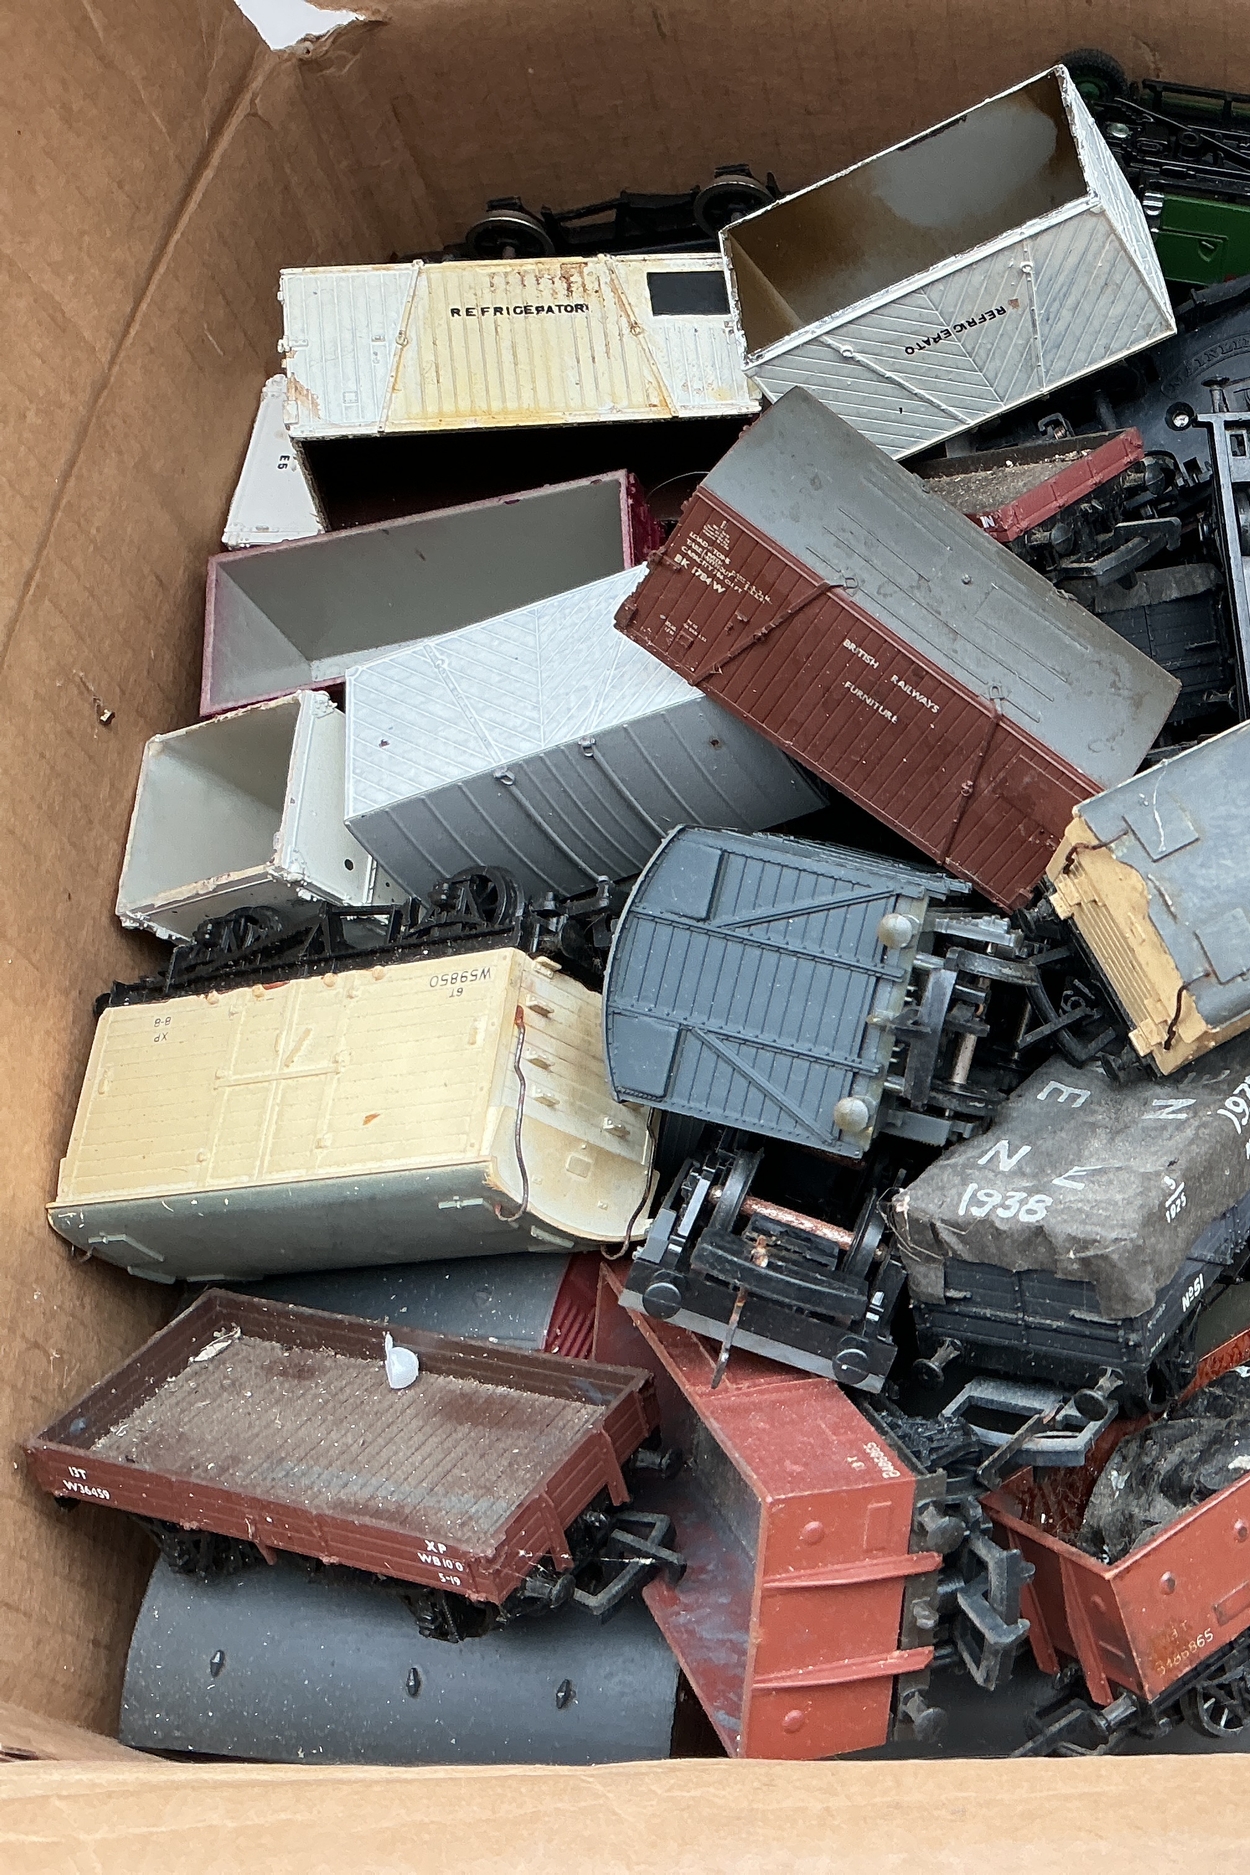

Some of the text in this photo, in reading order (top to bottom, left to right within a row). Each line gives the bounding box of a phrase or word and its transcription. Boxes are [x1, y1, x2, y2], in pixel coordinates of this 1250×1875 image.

[689, 531, 709, 548] LOAD
[674, 553, 691, 570] BK
[681, 545, 714, 571] CAPACITY
[842, 638, 940, 714] BRITISH RAILWAYS
[844, 680, 898, 725] FURNITURE
[429, 966, 492, 988] W59850
[958, 1182, 1054, 1223] 1938
[62, 1479, 110, 1500] W36459
[424, 1539, 447, 1554] XP
